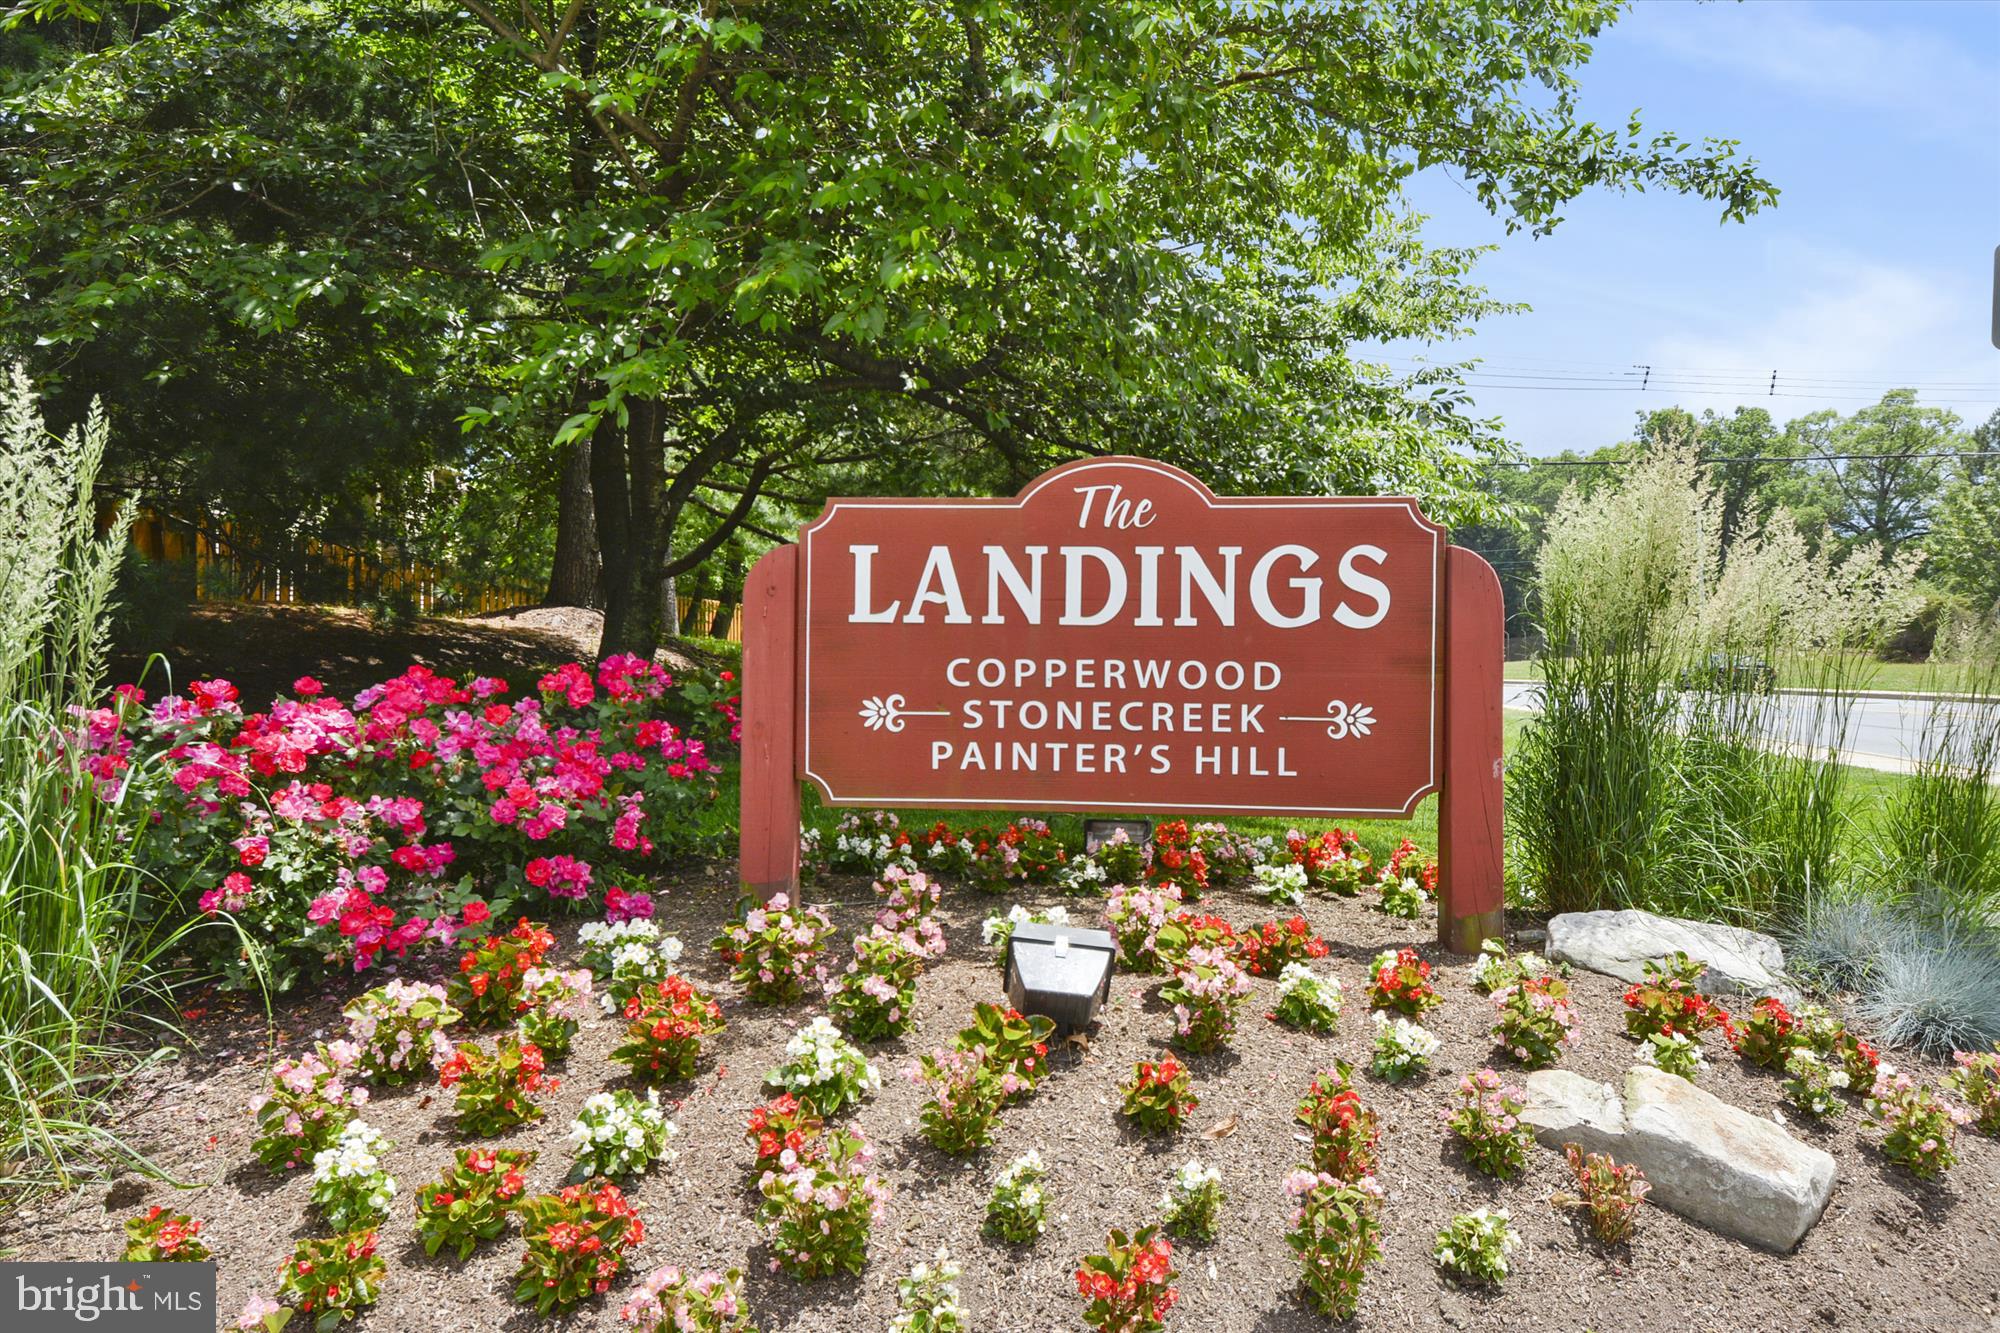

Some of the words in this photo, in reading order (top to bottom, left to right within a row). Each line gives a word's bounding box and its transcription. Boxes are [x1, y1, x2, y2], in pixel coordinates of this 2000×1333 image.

[1074, 485, 1156, 529] The
[849, 545, 1390, 629] LANDINGS
[947, 658, 1281, 690] COPPERWOOD
[964, 700, 1264, 732] STONECREEK
[932, 742, 1170, 773] PAINTER’S
[1196, 746, 1297, 776] HILL
